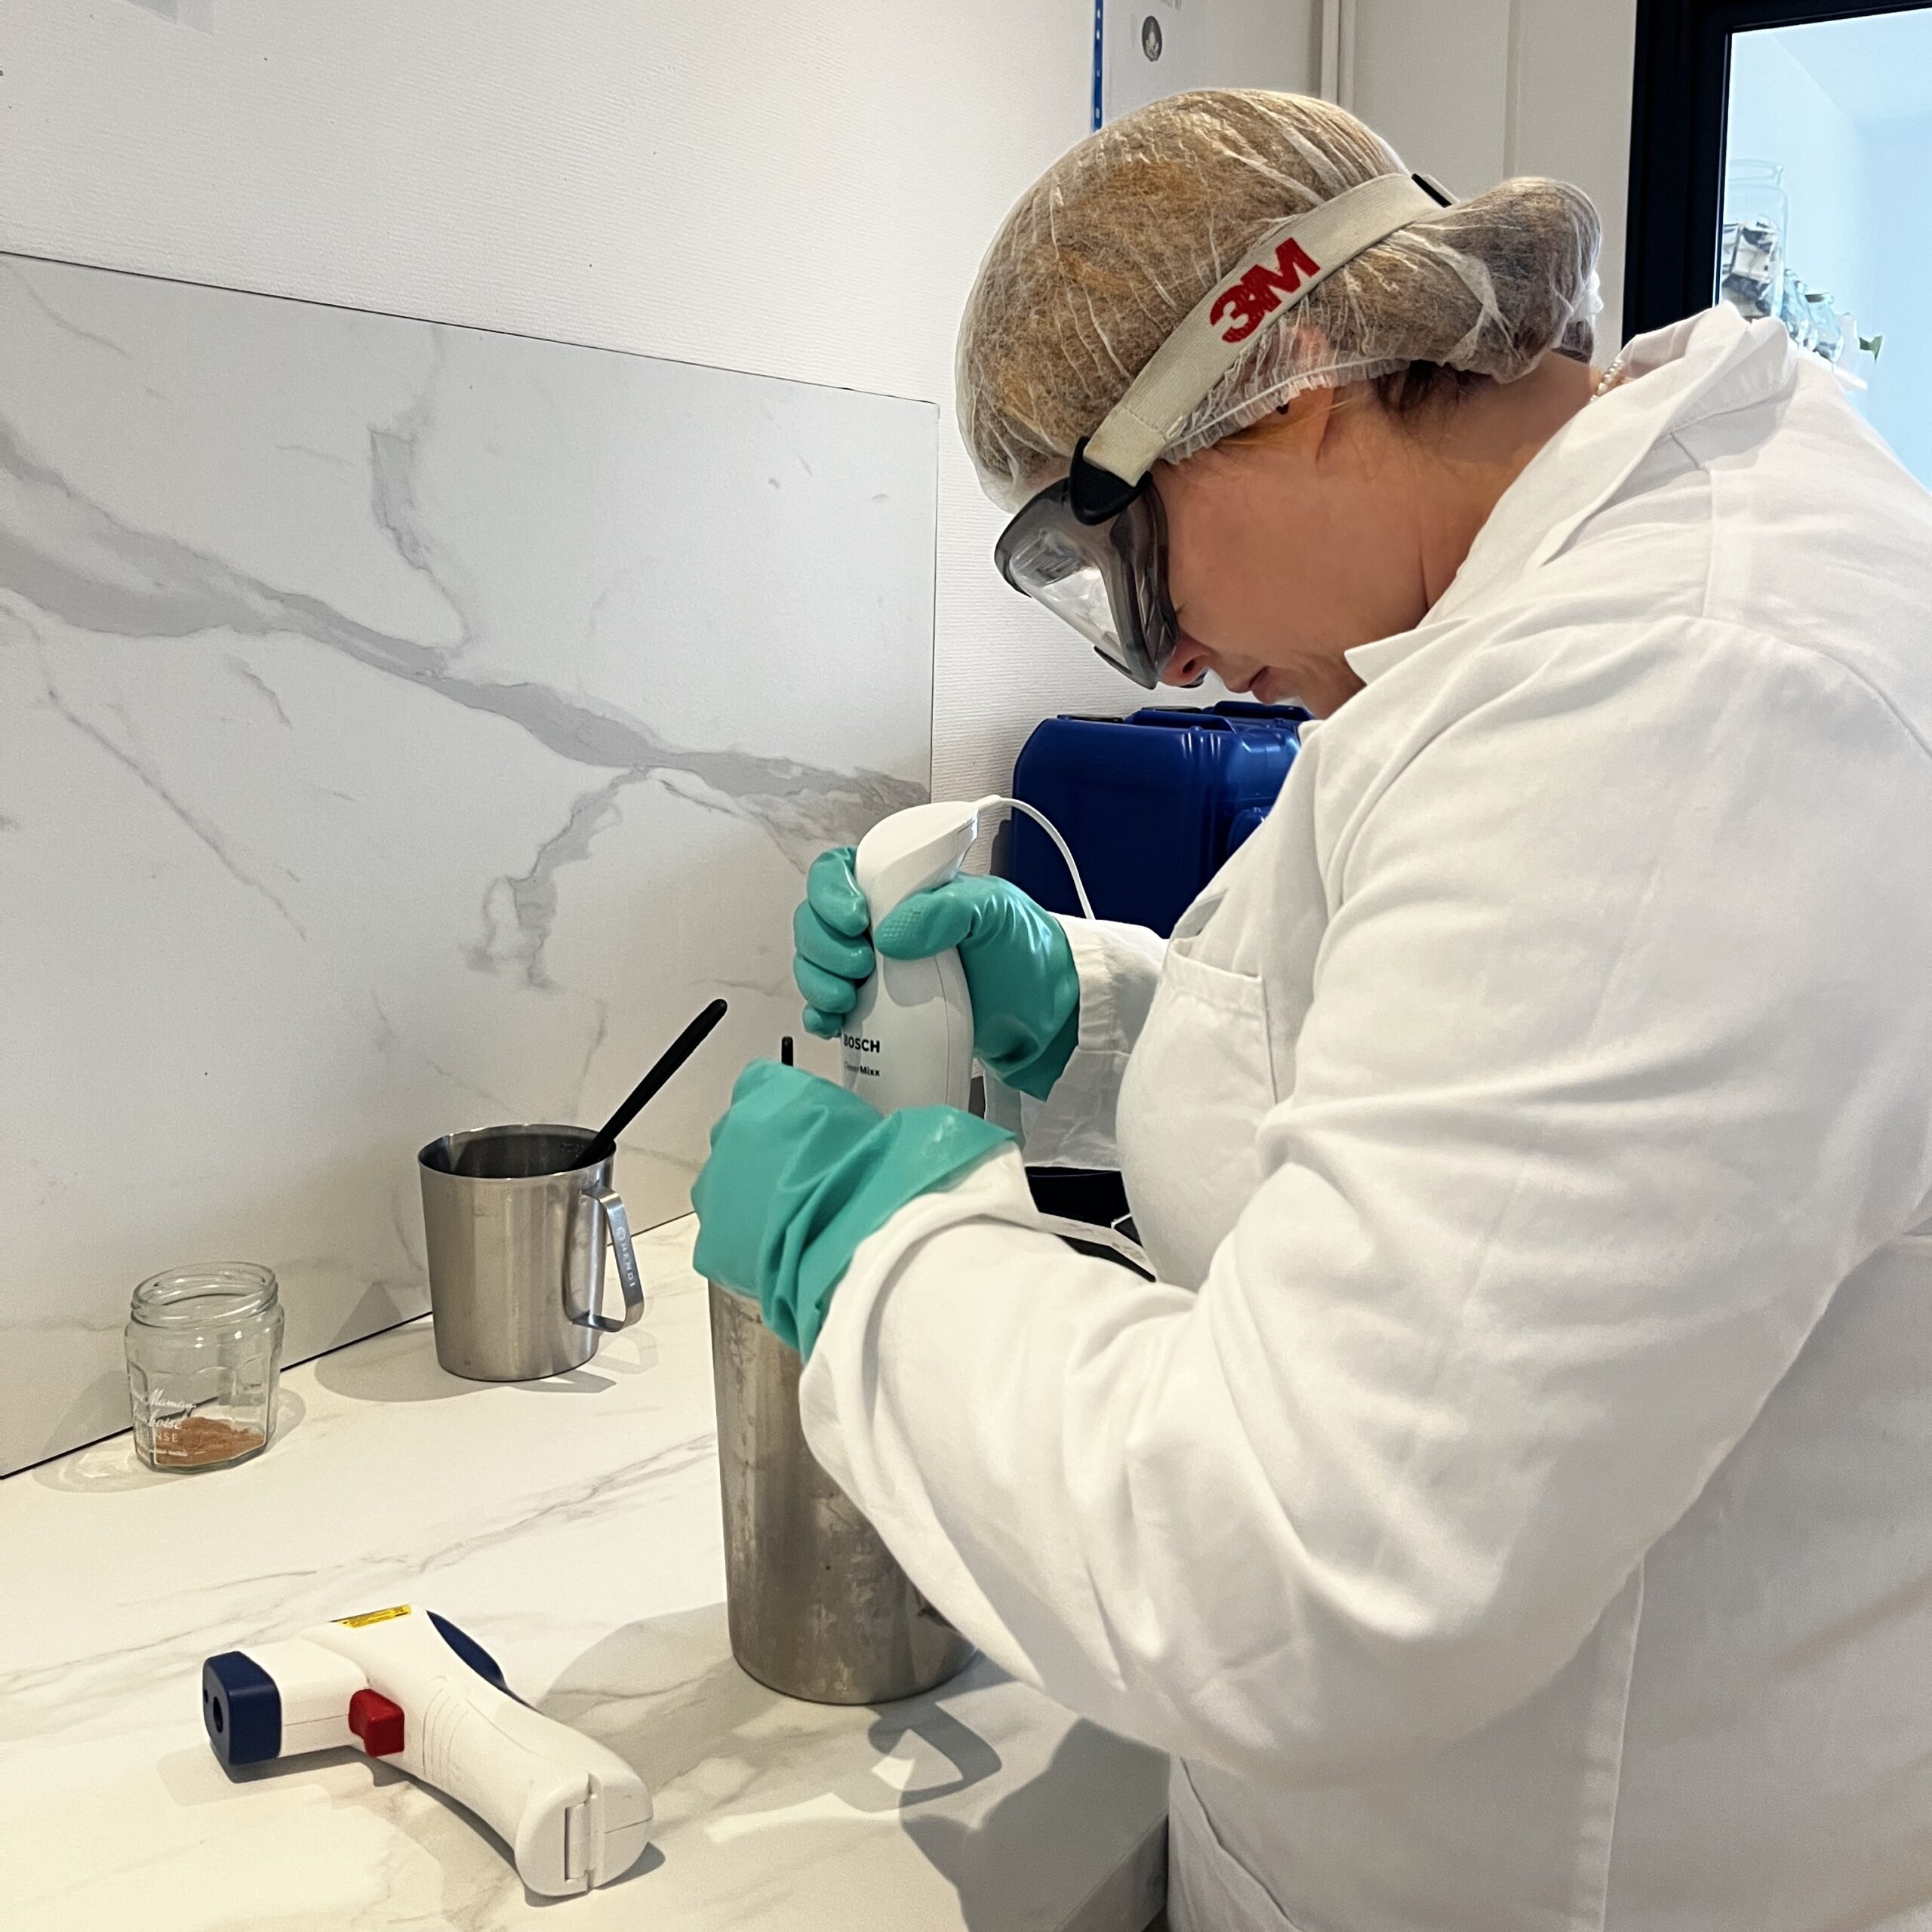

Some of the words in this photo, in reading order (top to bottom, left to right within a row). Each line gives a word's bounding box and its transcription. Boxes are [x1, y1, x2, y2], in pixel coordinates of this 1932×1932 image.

[1210, 237, 1321, 343] 3M
[843, 1033, 880, 1053] BOSCH
[620, 1242, 635, 1287] HENDI
